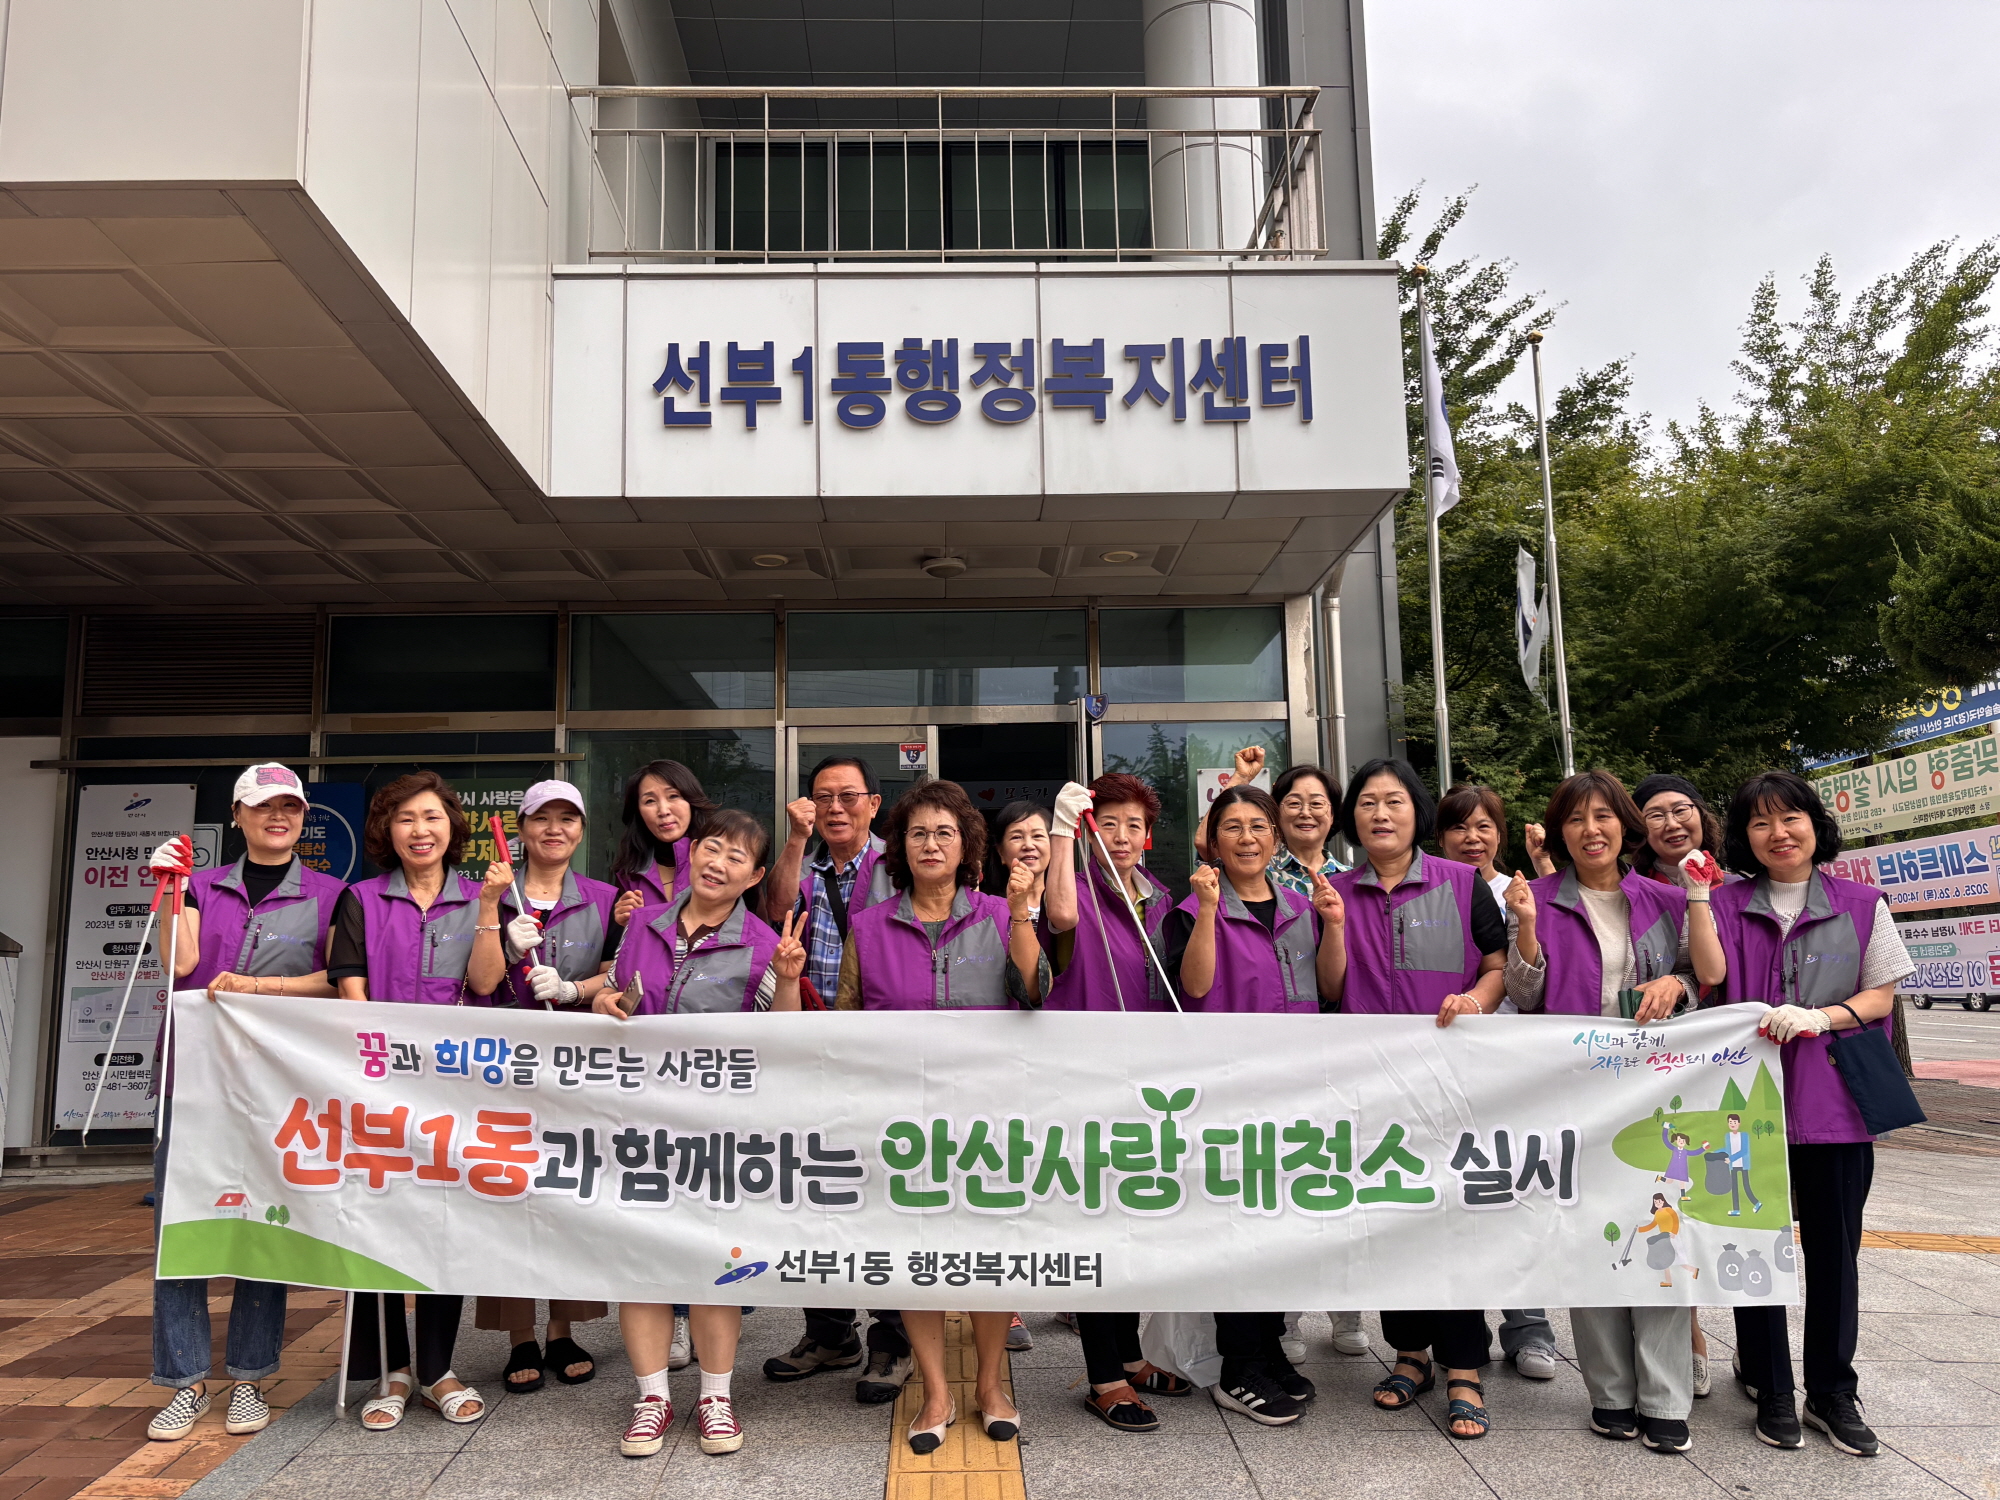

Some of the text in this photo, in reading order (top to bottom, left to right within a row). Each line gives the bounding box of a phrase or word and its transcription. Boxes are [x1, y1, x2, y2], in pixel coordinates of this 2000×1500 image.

[652, 335, 1314, 430] 선부1동행정복지센터
[479, 790, 524, 806] 사랑은
[86, 846, 138, 860] 안산시청
[84, 865, 128, 888] 이전
[109, 906, 126, 914] 업무
[85, 920, 115, 929] 2023년
[118, 920, 132, 929] 5월
[75, 960, 102, 969] 안산시
[104, 960, 130, 969] 단원구
[91, 971, 126, 980] 안산시청
[1573, 1029, 1628, 1057] 시민과
[356, 1031, 757, 1091] 꿈과 희망을 만드는 사람들
[1589, 1046, 1754, 1079] 자유로운 혁신도시 안산
[85, 1082, 149, 1092] 03-481-3607
[274, 1096, 1578, 1211] 선부1동과 함께하는 안산사랑 대청소 실시
[774, 1248, 1104, 1289] 선부1동 행정복지센터
